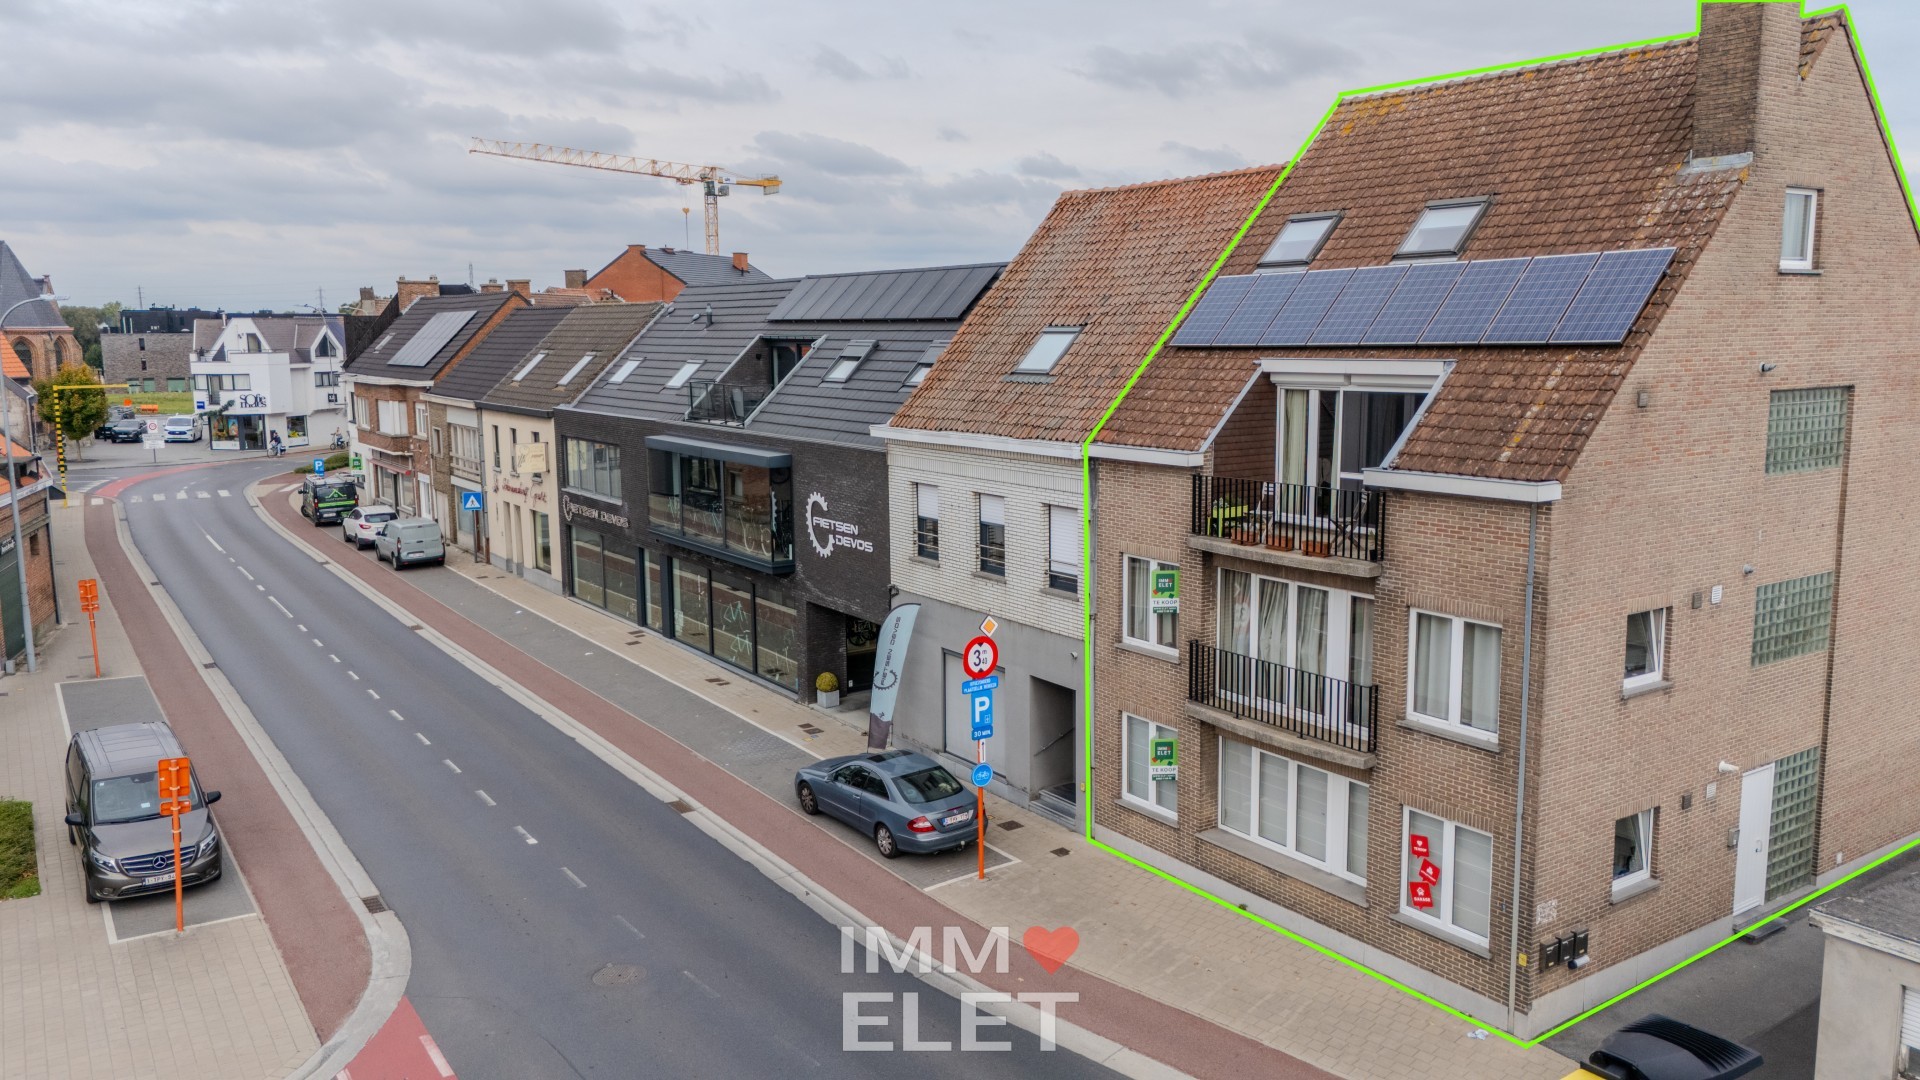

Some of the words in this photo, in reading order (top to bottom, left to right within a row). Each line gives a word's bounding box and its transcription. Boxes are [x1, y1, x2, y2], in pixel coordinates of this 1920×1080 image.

[315, 461, 322, 471] P
[812, 516, 858, 535] FIETSEN
[835, 535, 873, 553] DEVOS
[881, 649, 893, 686] FIETSEN
[890, 616, 902, 646] DEVOS
[973, 649, 982, 667] 3
[974, 696, 990, 723] P
[974, 730, 982, 738] 30
